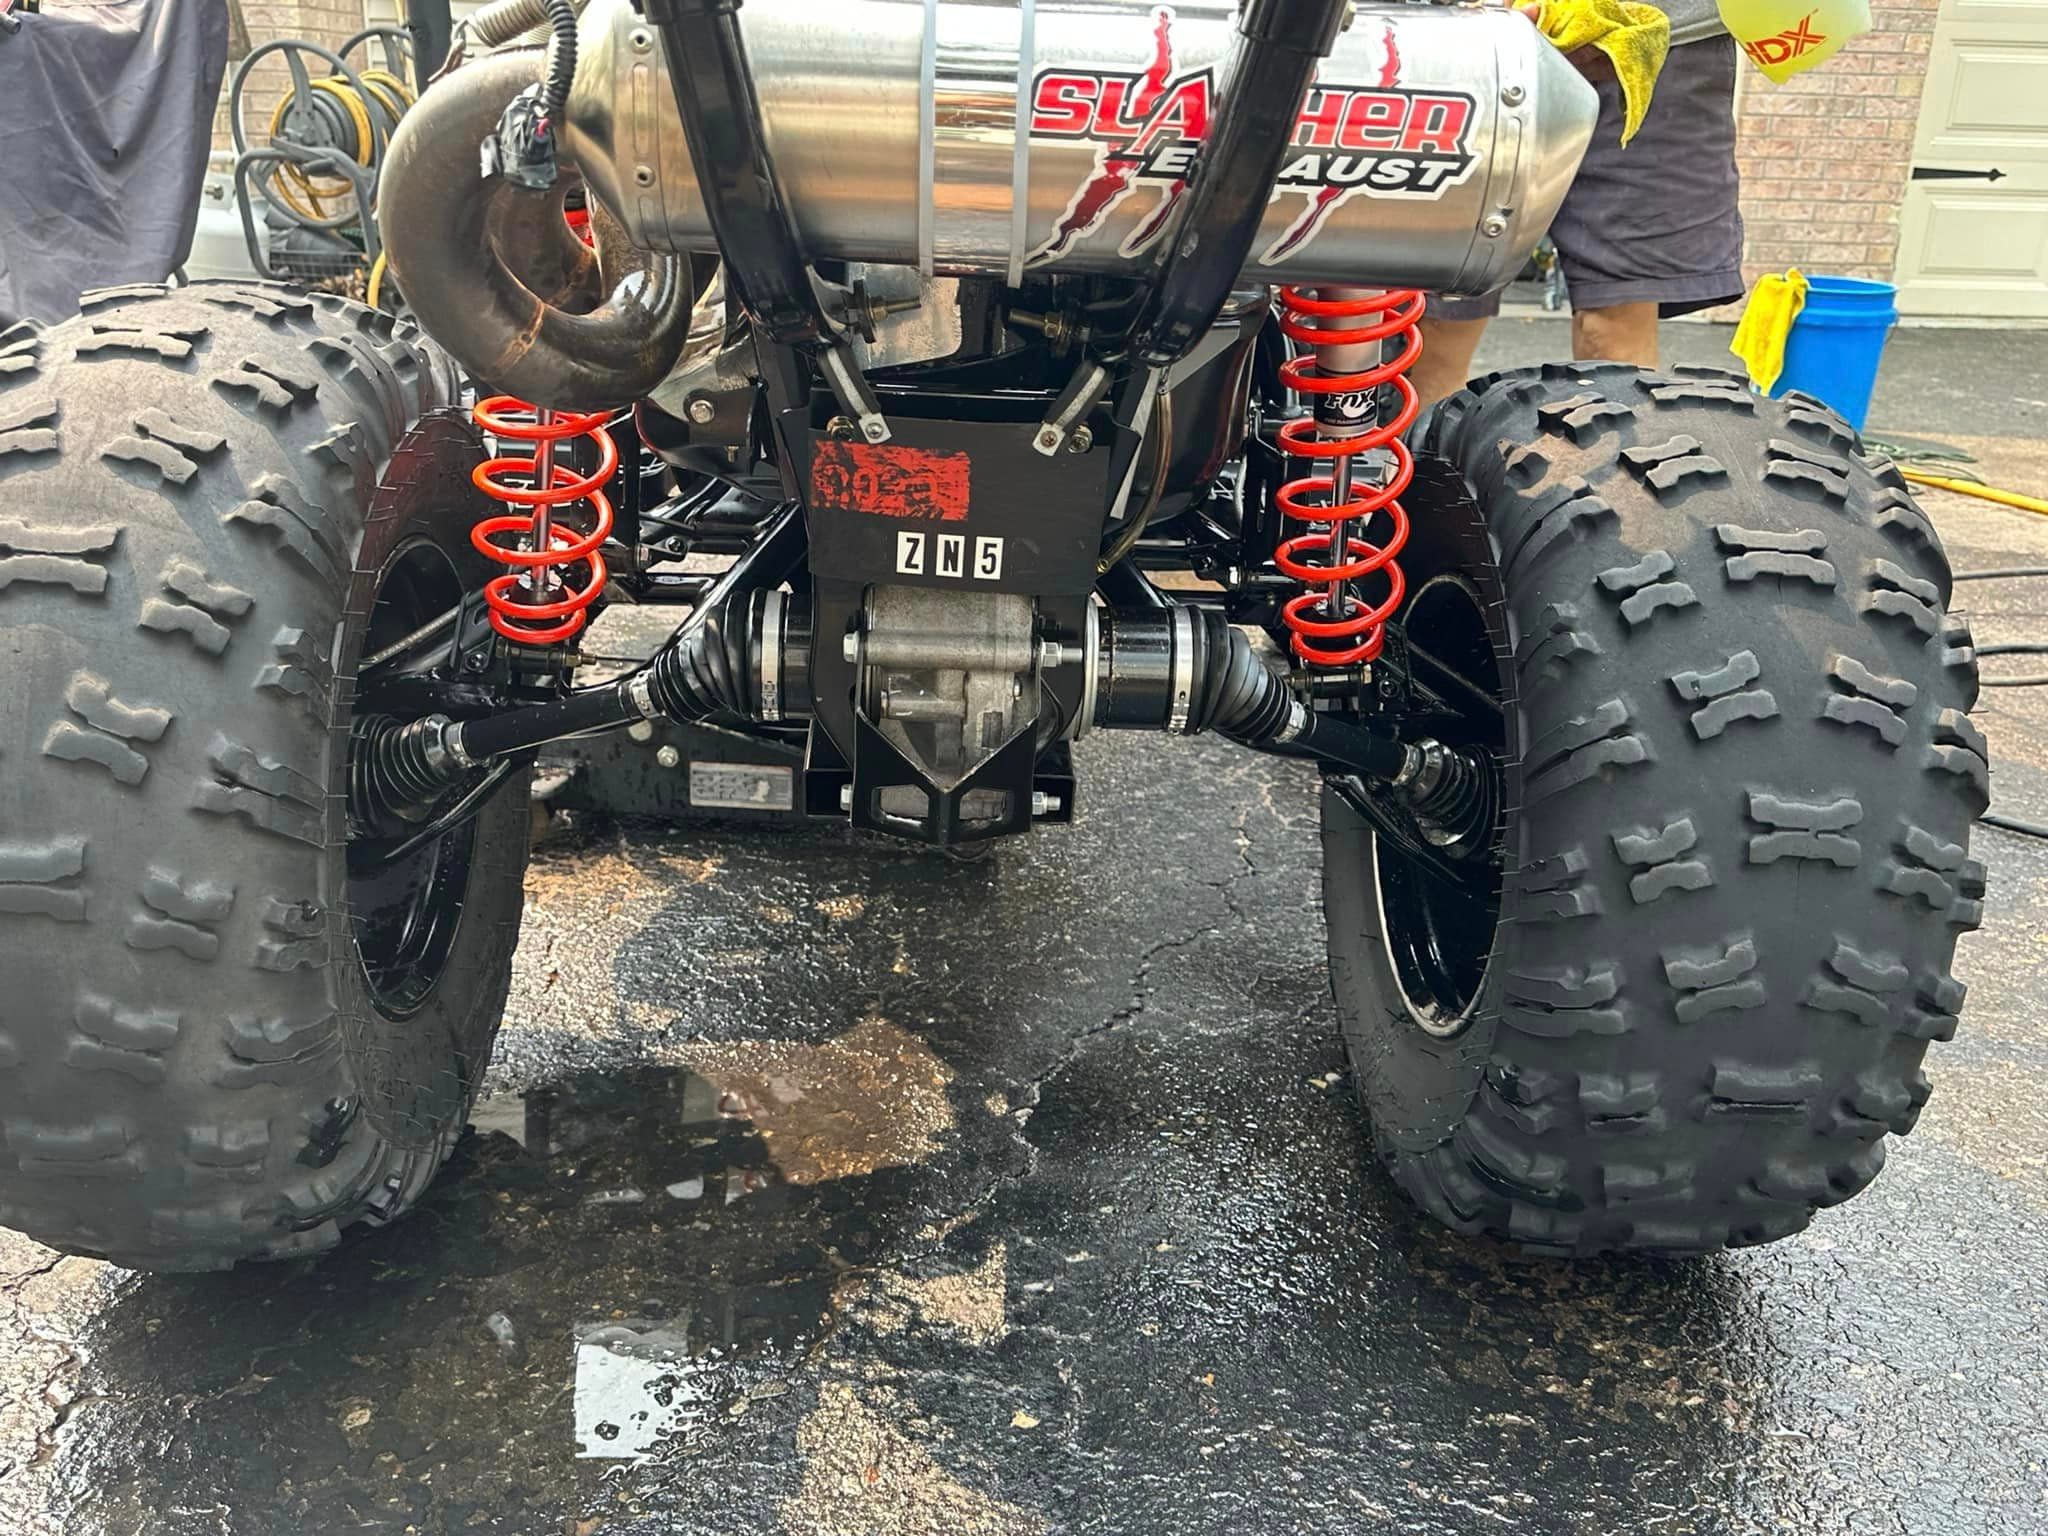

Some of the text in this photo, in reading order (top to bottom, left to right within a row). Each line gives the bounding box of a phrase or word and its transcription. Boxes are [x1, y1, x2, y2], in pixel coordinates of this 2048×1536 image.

[1031, 74, 1474, 153] SLAHER
[1150, 147, 1460, 186] EAUST
[1324, 387, 1376, 411] FOX
